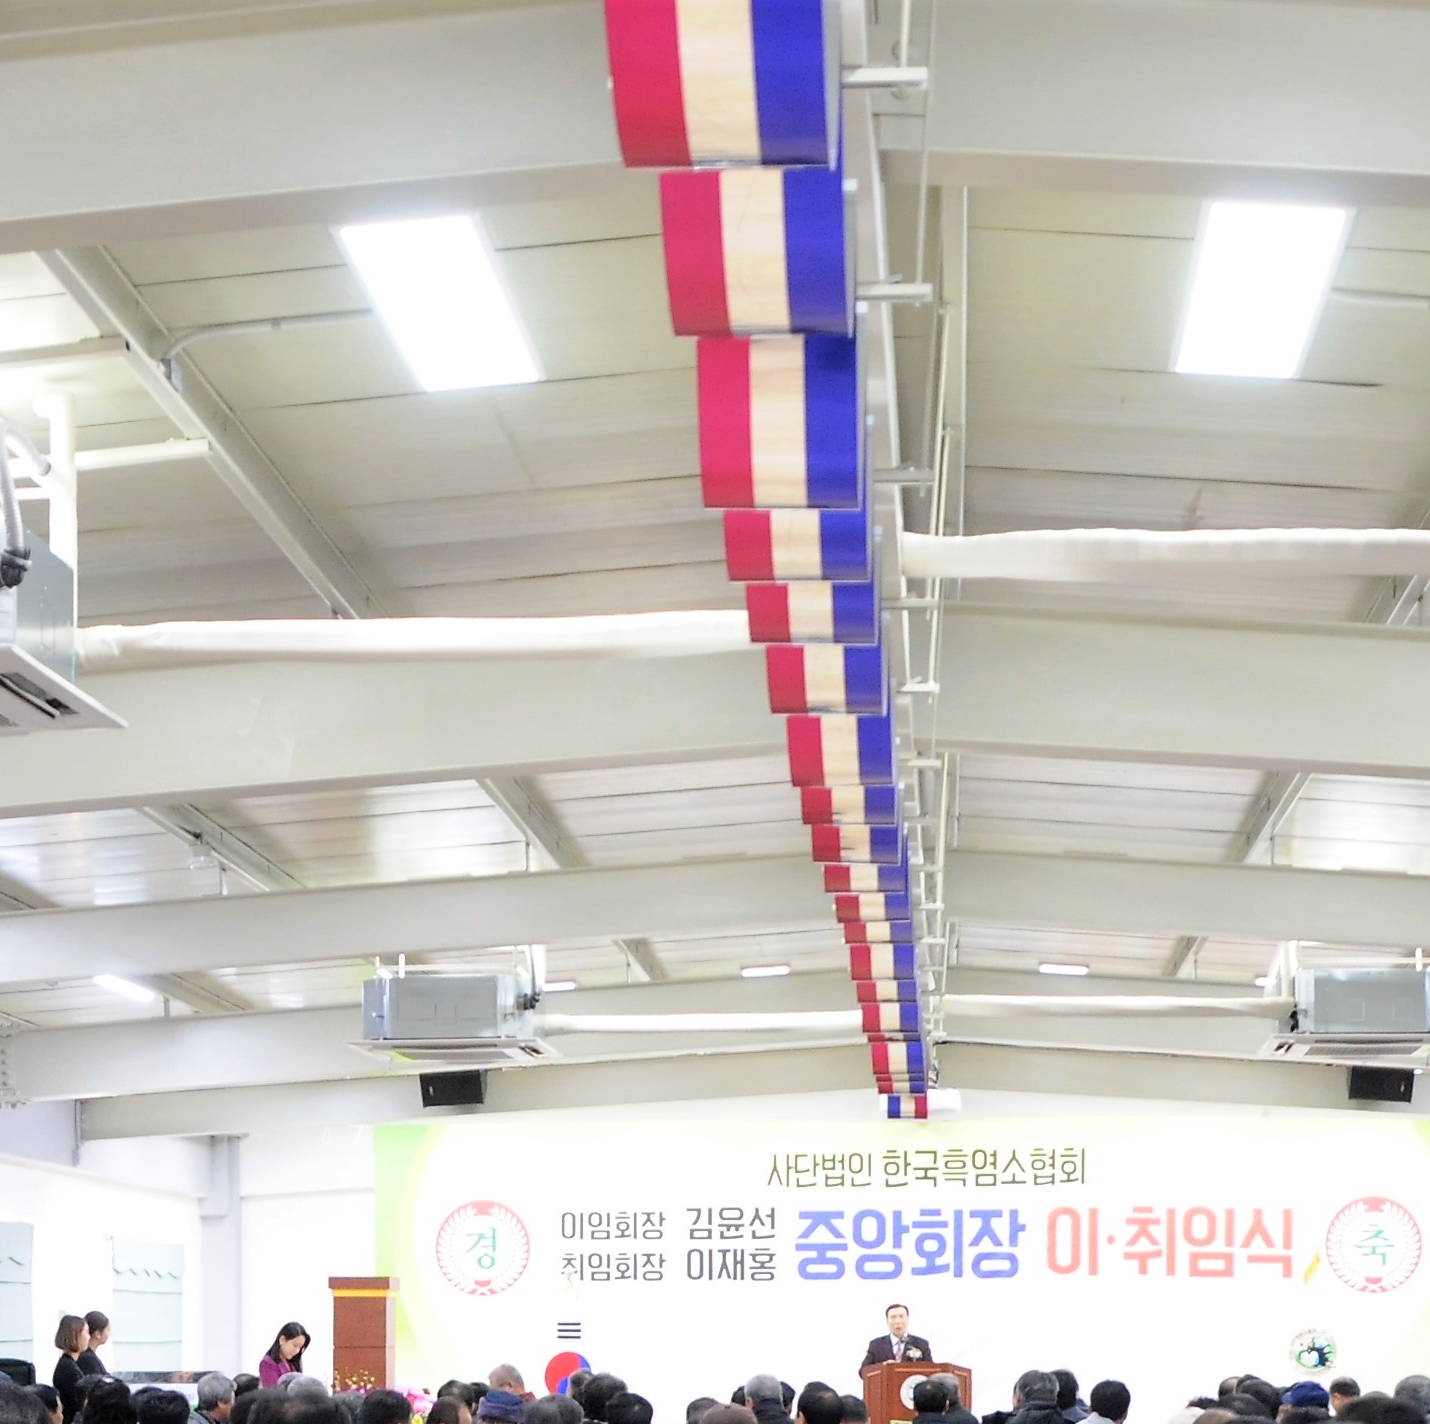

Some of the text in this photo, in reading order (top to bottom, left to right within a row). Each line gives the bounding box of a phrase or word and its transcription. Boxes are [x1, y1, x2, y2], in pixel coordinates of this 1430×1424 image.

[767, 1147, 1085, 1188] 사단법인 한국흑염소협회
[561, 1206, 776, 1240] 이임회장 김윤선
[465, 1227, 497, 1269] 경
[561, 1247, 777, 1282] 취임회장 이재홍
[794, 1208, 1027, 1281] 중앙회장
[1353, 1223, 1395, 1266] 축
